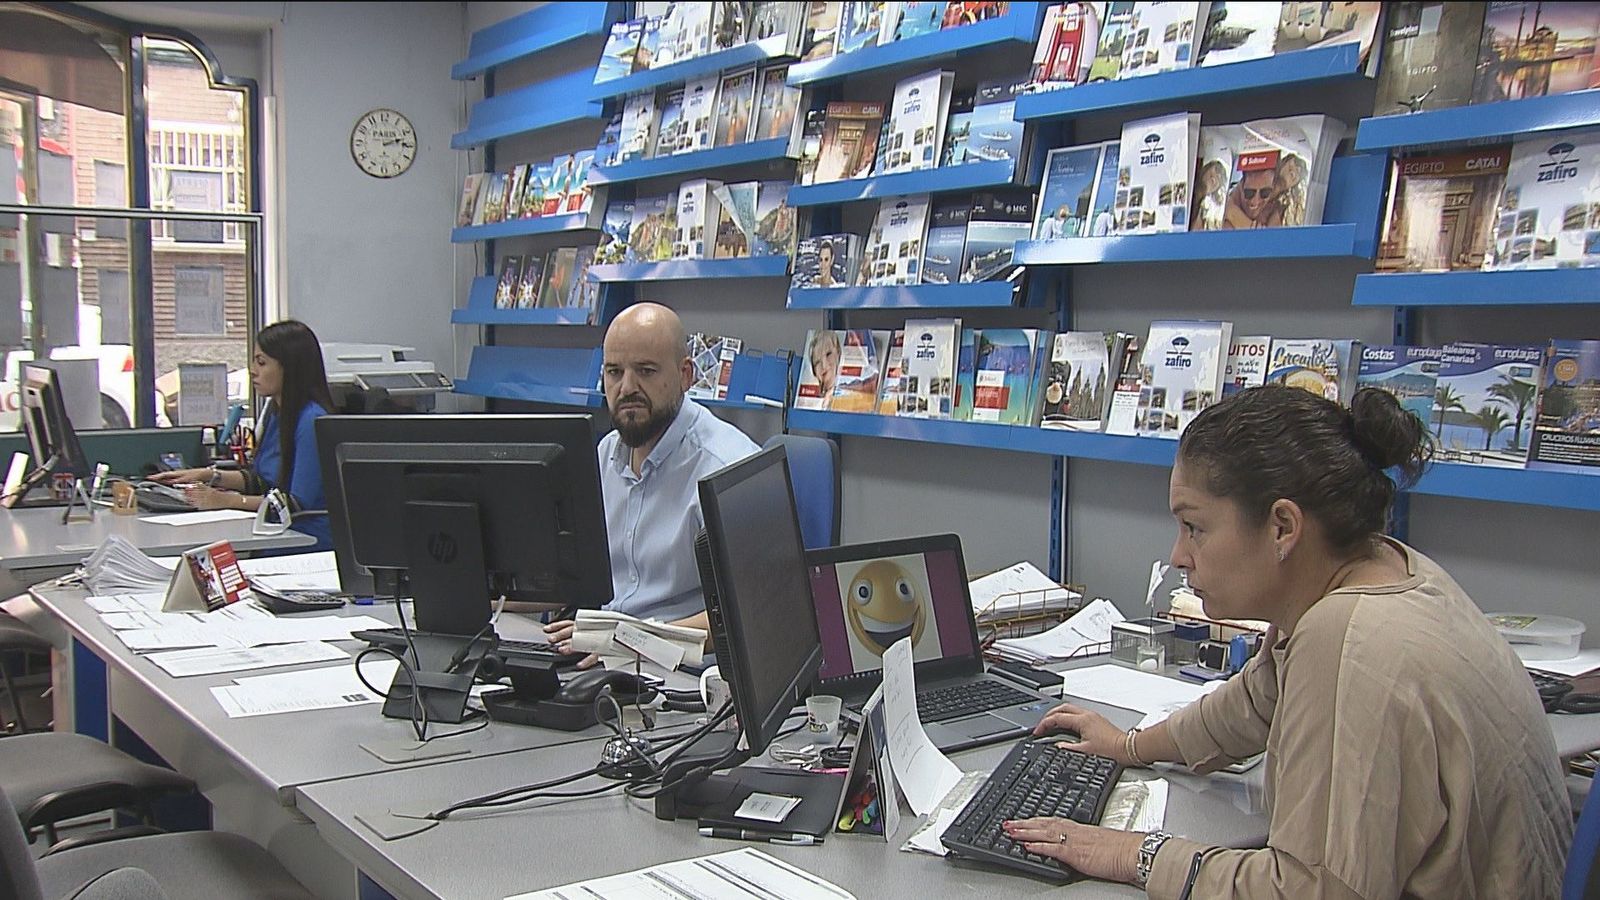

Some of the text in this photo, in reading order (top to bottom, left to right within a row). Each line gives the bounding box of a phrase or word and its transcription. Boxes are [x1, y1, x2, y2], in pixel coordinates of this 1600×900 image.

[1140, 152, 1164, 165] zafiro
[1403, 156, 1500, 175] EGIPTO CATAI
[1537, 165, 1578, 182] zafiro
[1229, 344, 1265, 356] UITOS
[1362, 349, 1395, 360] Costas
[1494, 348, 1540, 361] europlayas
[1165, 355, 1192, 368] zafiro
